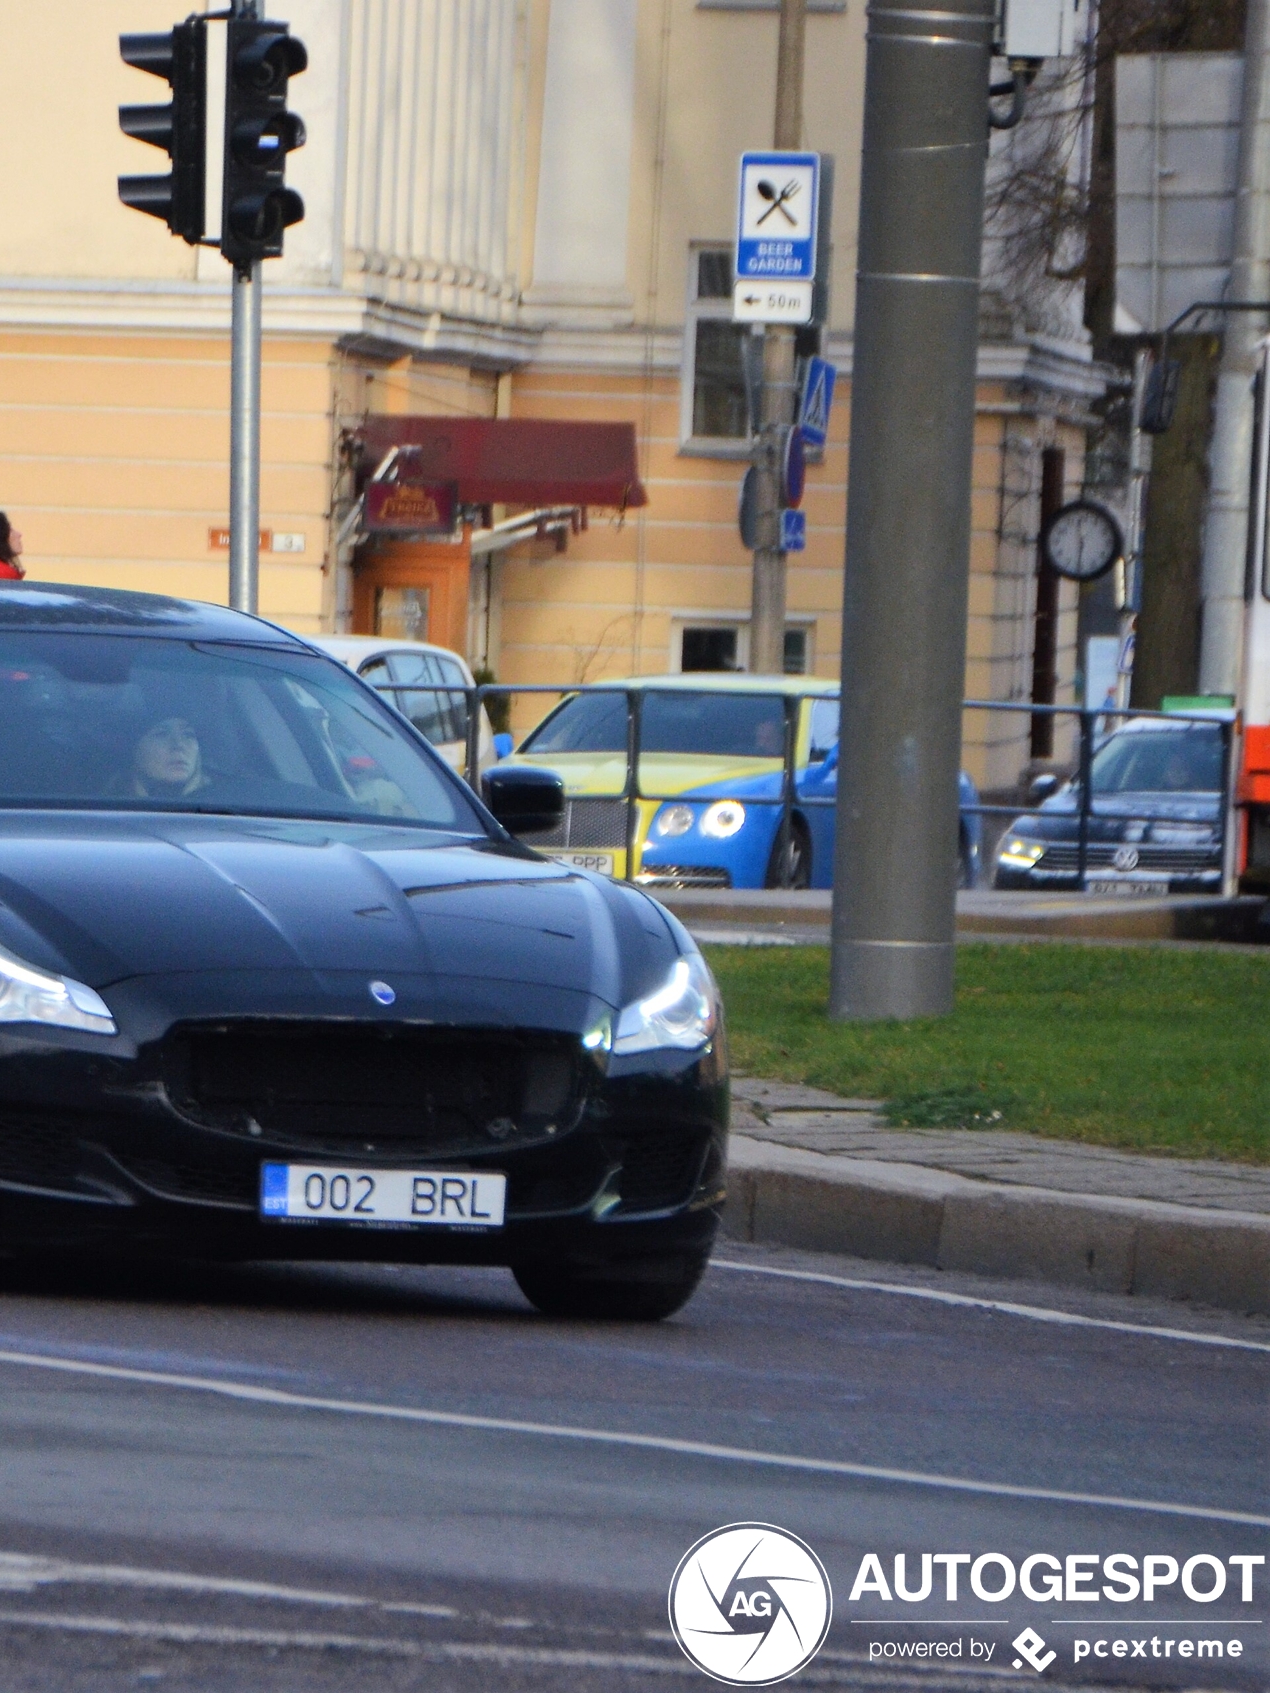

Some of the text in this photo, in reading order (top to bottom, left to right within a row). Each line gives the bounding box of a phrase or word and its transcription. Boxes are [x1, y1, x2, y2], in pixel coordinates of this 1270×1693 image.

[759, 243, 793, 256] BEER
[748, 257, 802, 272] GARDEN
[304, 1172, 491, 1219] 002 BRL
[264, 1199, 288, 1210] EST
